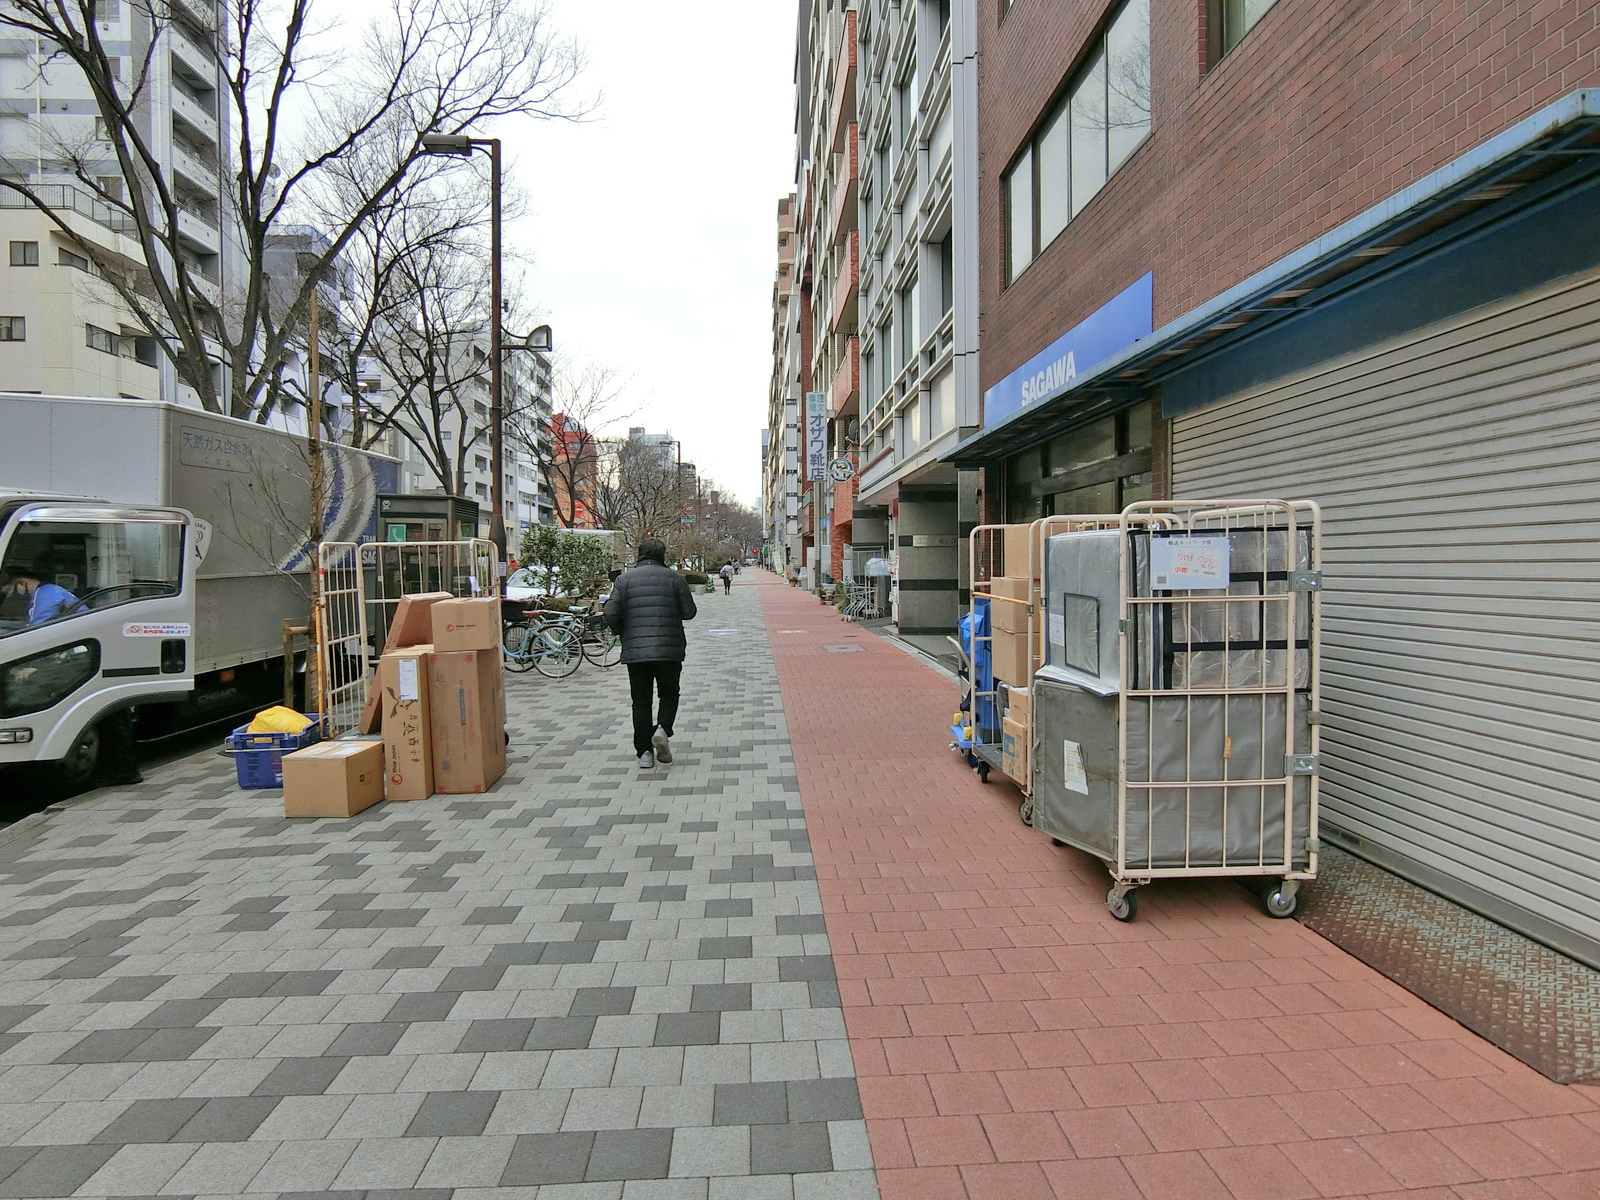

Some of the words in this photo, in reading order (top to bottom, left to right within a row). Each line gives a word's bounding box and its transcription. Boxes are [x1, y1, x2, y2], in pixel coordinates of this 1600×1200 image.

[817, 393, 825, 412] 注文
[1022, 351, 1076, 406] SAGAWA
[810, 413, 825, 480] オザワ靴店
